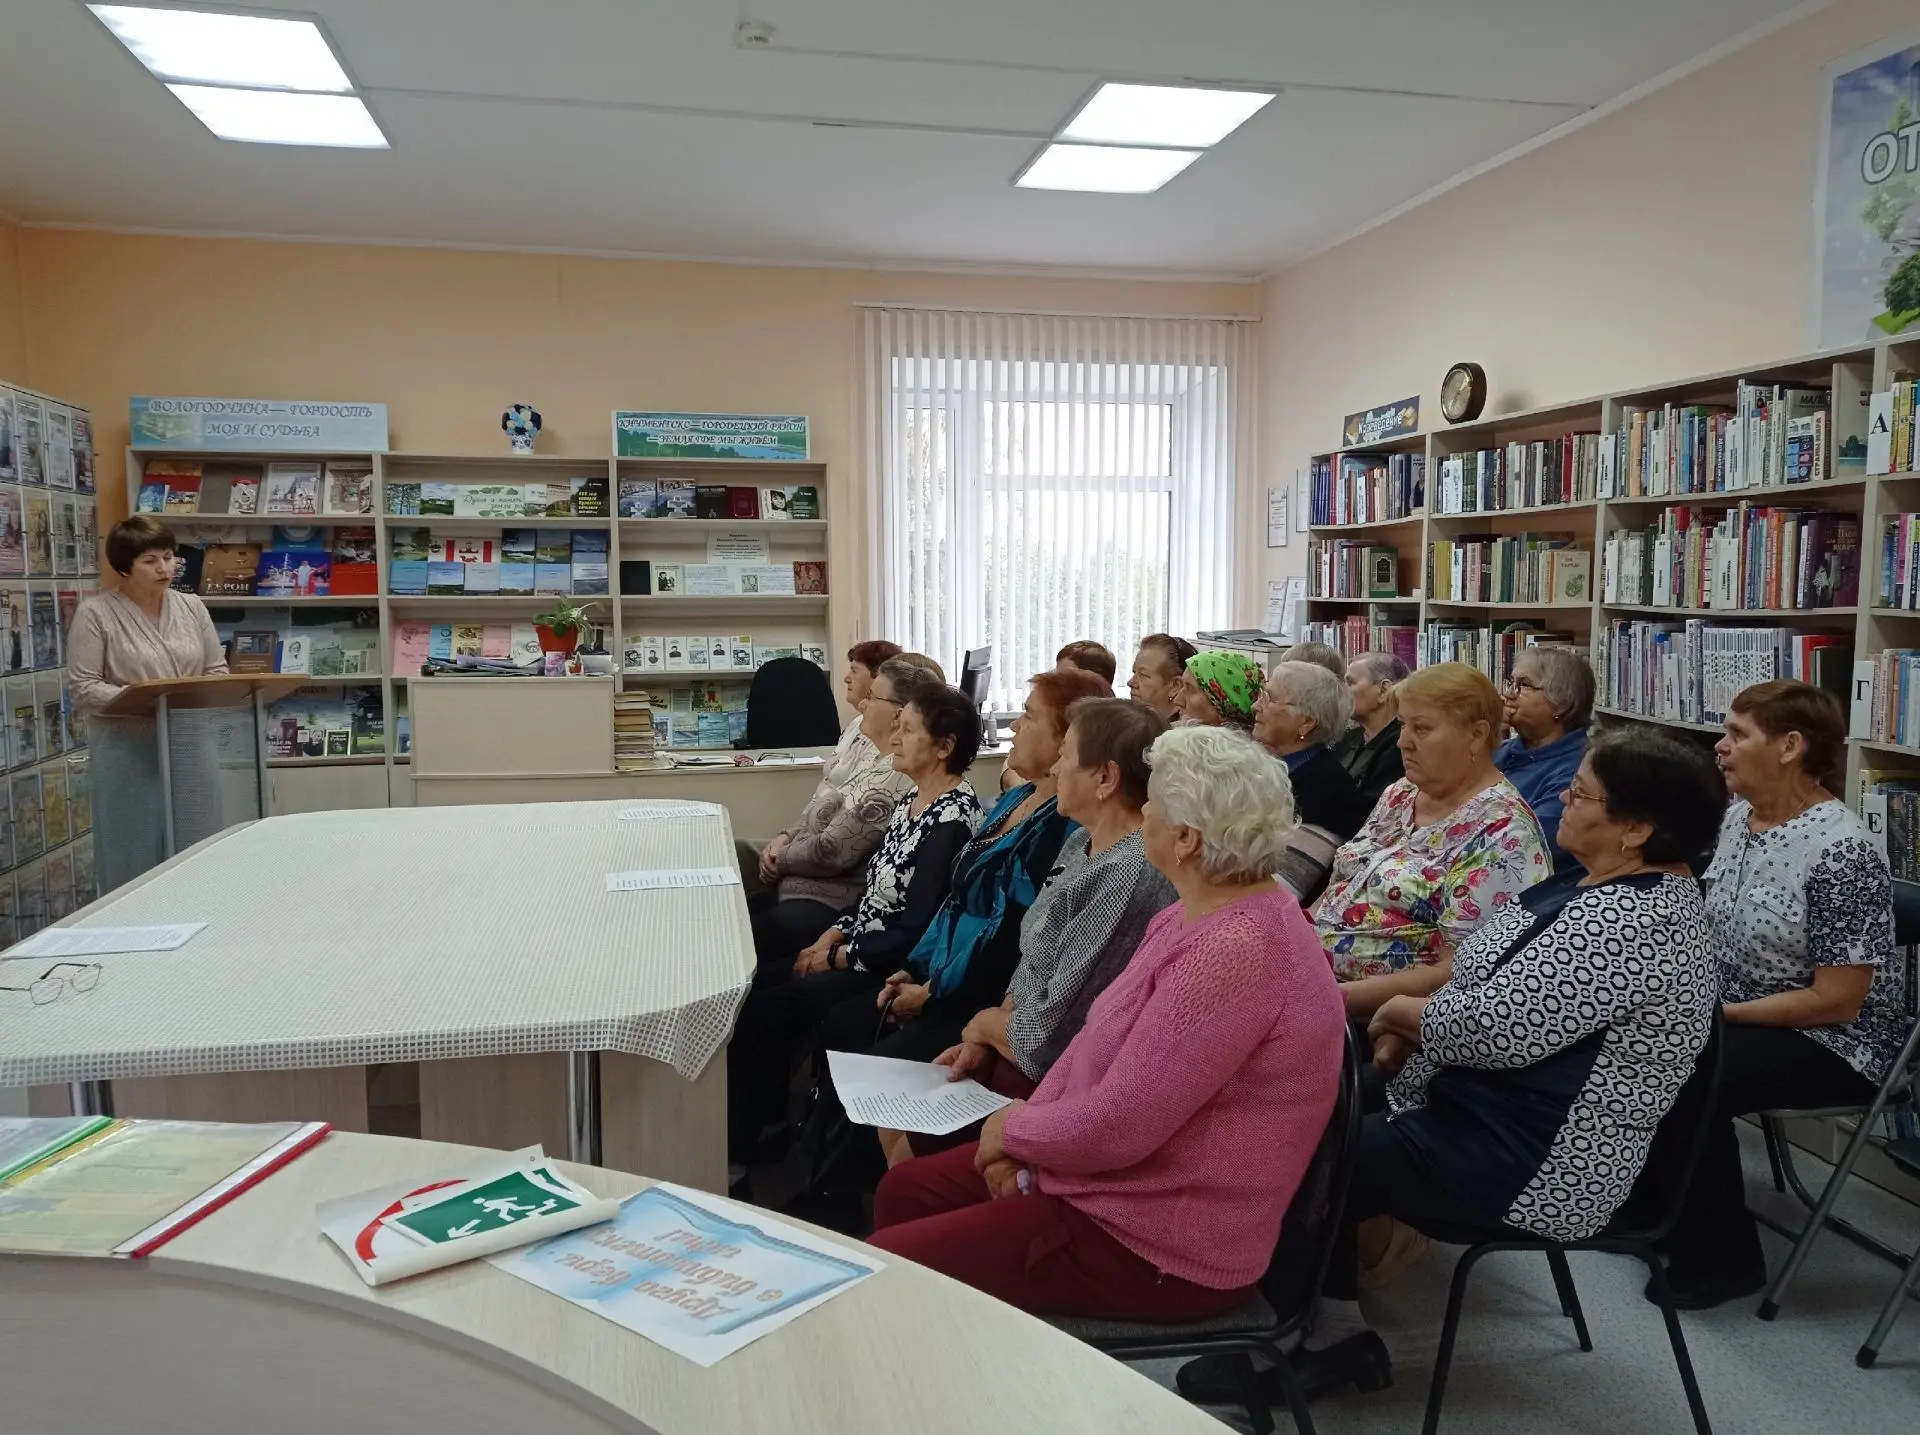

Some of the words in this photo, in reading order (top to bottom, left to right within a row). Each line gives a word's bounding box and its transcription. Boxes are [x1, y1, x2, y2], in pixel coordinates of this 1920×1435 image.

[289, 404, 373, 418] ГОРДОСТЬ
[207, 423, 242, 437] МОЯ
[243, 423, 258, 436] И
[260, 424, 320, 438] СУДЬБА
[769, 421, 804, 432] РАЙОН
[1358, 414, 1402, 436] Краеведение
[1870, 412, 1890, 435] А
[717, 436, 736, 444] МЫ
[738, 435, 777, 446] ЖИВЁМ
[1855, 680, 1870, 701] Г
[1866, 812, 1883, 834] Е
[653, 1228, 742, 1259] иди!
[582, 1226, 758, 1297] библиотеку
[633, 1279, 741, 1321] Друга
[756, 1288, 783, 1302] в
